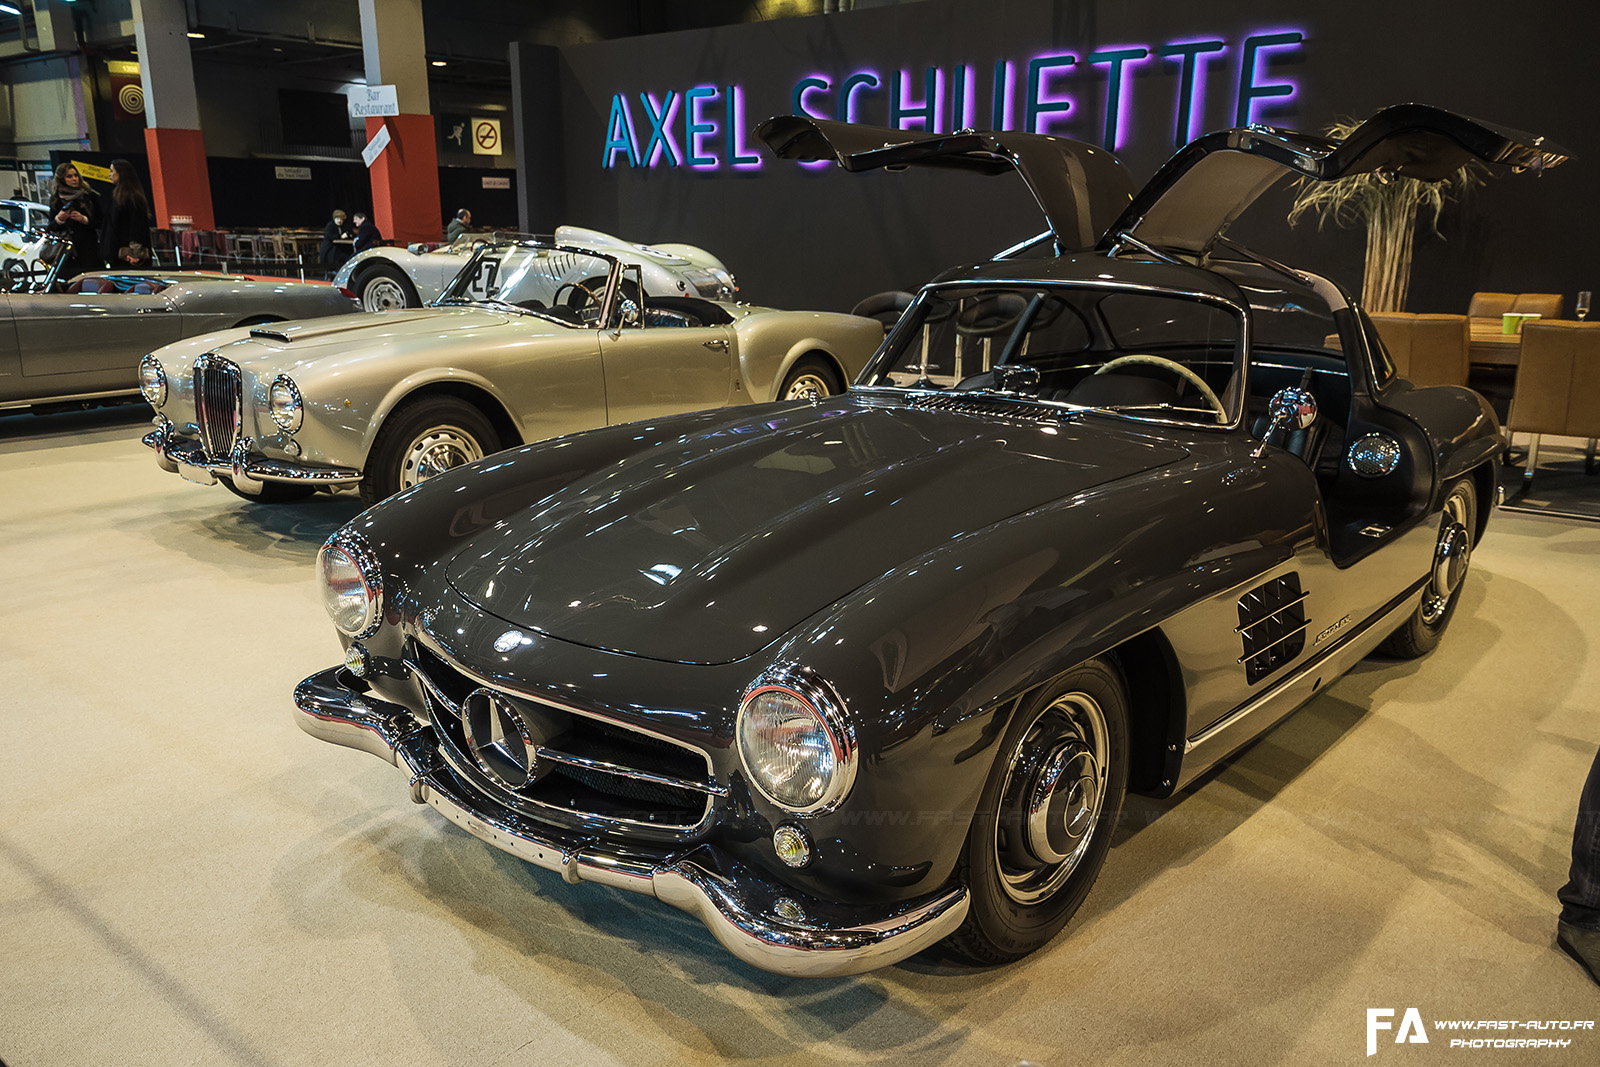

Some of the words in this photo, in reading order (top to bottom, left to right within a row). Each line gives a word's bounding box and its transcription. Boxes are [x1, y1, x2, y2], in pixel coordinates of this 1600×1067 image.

[353, 102, 396, 115] Restaurant
[366, 89, 380, 101] Bar
[602, 84, 763, 169] AXEL
[791, 32, 1303, 166] SCHUETTE
[472, 257, 501, 298] 27
